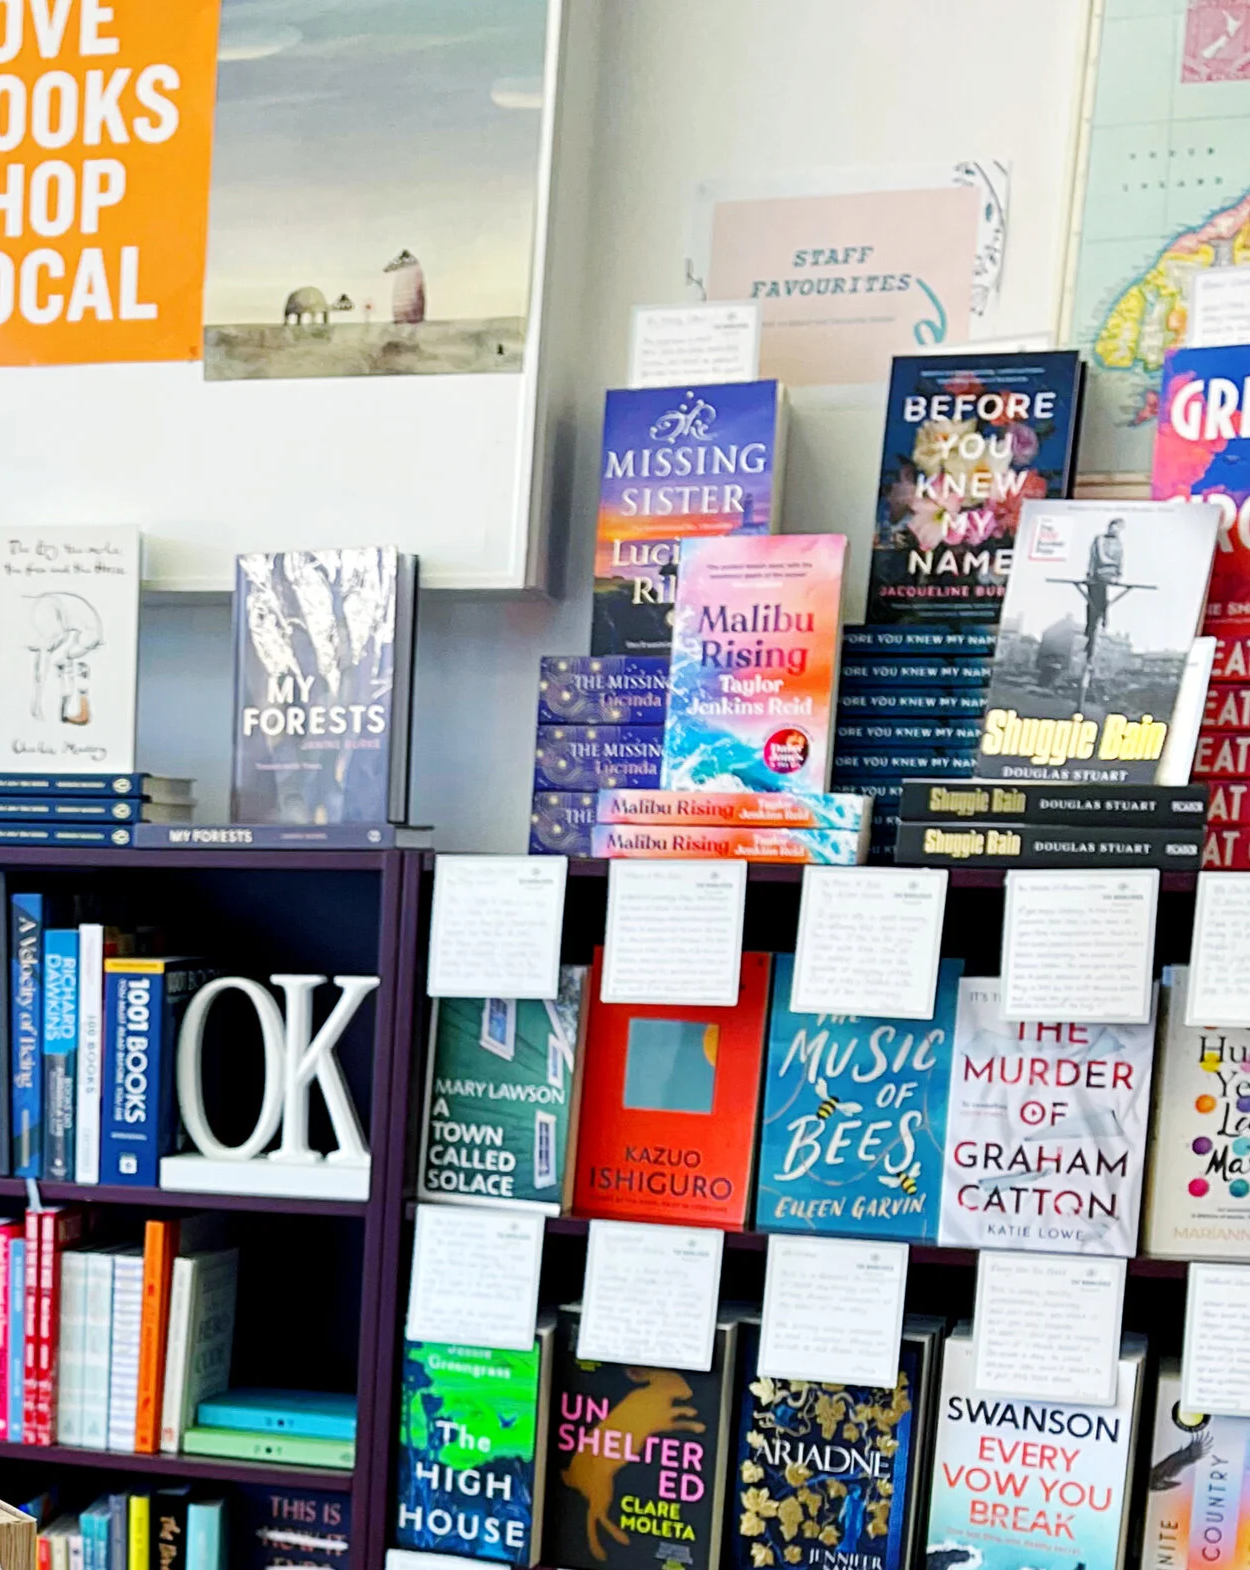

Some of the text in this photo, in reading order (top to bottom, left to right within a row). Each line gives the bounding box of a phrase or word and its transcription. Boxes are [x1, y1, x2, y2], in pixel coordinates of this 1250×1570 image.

[793, 245, 874, 267] STAFF
[751, 273, 912, 299] FAVOURITES
[903, 392, 1057, 422] BEFORE
[604, 443, 767, 479] MISSING
[940, 433, 1013, 460] YOU
[916, 470, 1028, 499] KNEW
[621, 484, 745, 516] SISTER
[942, 510, 995, 536] MY
[908, 549, 1014, 575] NAME
[878, 584, 970, 597] JACQUELINE
[700, 603, 815, 634] Malibu
[700, 639, 809, 678] Rising
[267, 675, 315, 704] MY
[719, 674, 784, 701] Taylor
[242, 704, 386, 737] FORESTS
[686, 697, 812, 717] Jenkins Reid
[982, 708, 1167, 766] Shuggie Bain
[1002, 766, 1129, 781] DOUGLAS STUART
[610, 798, 735, 820] Malibu Rising
[929, 786, 1027, 816] Shuggie Bain
[169, 830, 253, 843] MY FORESTS
[606, 833, 731, 856] Malibu Rising
[923, 828, 1022, 859] Shuggie Bain
[1033, 842, 1152, 854] DOUGLAS STUART
[19, 936, 38, 1008] Velocity
[45, 953, 62, 1041] DAWKINS
[62, 956, 76, 1040] RICHARD
[20, 1011, 38, 1038] of
[14, 1037, 38, 1088] Being
[124, 977, 150, 1124] 1001 BOOKS
[779, 1024, 946, 1083] MUSIC
[177, 973, 381, 1165] OK
[962, 1054, 1134, 1090] MURDER
[434, 1079, 565, 1105] MARY LAWSON
[875, 1081, 918, 1110] OF
[433, 1098, 451, 1117] A
[1019, 1101, 1069, 1128] OF
[432, 1121, 504, 1147] TOWN
[774, 1110, 922, 1181] BEES
[429, 1145, 517, 1172] CALLED
[624, 1146, 702, 1169] KAZUO
[954, 1140, 1129, 1179] GRAHAM
[426, 1169, 515, 1198] SOLACE
[589, 1168, 734, 1201] ISHIGURO
[774, 1193, 927, 1220] EILEEN GARVIN
[956, 1183, 1120, 1220] CATTON
[987, 1223, 1087, 1243] KATIE LOWE
[560, 1392, 611, 1422] UN
[947, 1396, 1121, 1444] SWANSON
[435, 1419, 492, 1455] The
[557, 1425, 705, 1472] SHELTER
[752, 1439, 891, 1480] ARIADNE
[978, 1435, 1082, 1473] EVERY
[415, 1463, 512, 1501] HIGH
[658, 1470, 705, 1503] ED
[942, 1462, 1114, 1513] VOW YOU
[270, 1496, 342, 1525] THIS IS
[620, 1495, 681, 1520] CLARE
[968, 1502, 1076, 1542] BREAK
[1202, 1454, 1230, 1562] COUNTRY
[398, 1504, 526, 1550] HOUSE
[620, 1515, 696, 1542] MOLETA
